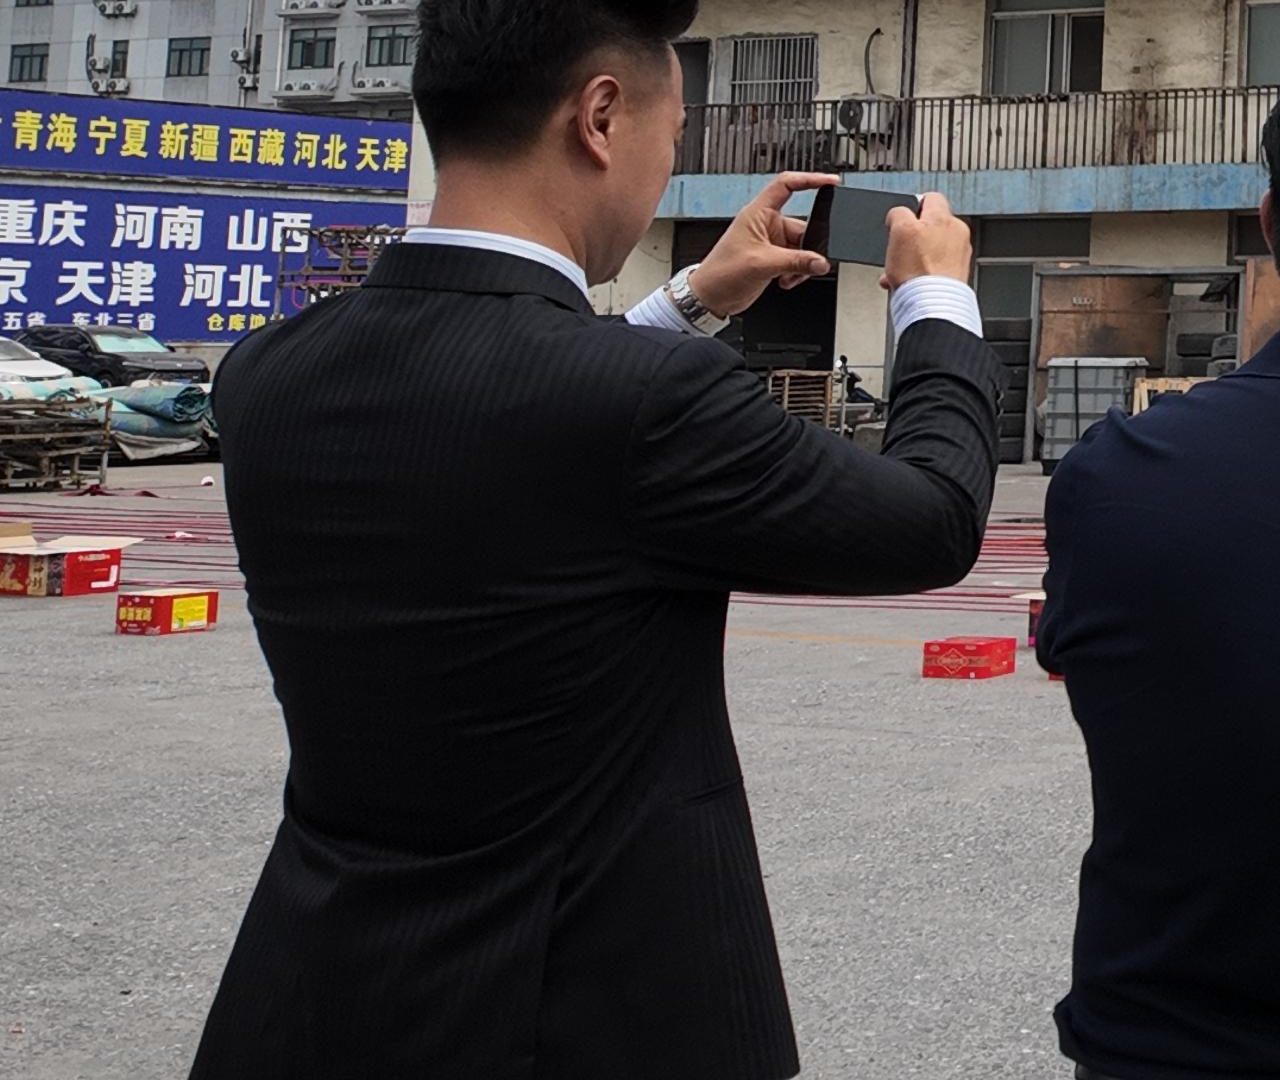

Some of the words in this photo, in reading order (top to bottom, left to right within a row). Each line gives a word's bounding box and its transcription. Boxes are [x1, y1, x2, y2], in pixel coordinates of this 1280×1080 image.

[12, 110, 77, 153] 青海
[88, 116, 151, 158] 宁夏
[158, 121, 220, 162] 新疆
[229, 128, 286, 166] 西藏
[293, 132, 348, 170] 河北
[355, 137, 408, 174] 天津
[0, 198, 88, 247] 重庆
[110, 202, 204, 251] 河南
[227, 209, 313, 253] 山西
[0, 257, 32, 305] 京
[55, 260, 157, 307] 天津
[179, 263, 272, 308] 河北
[207, 313, 286, 332] 仓库地
